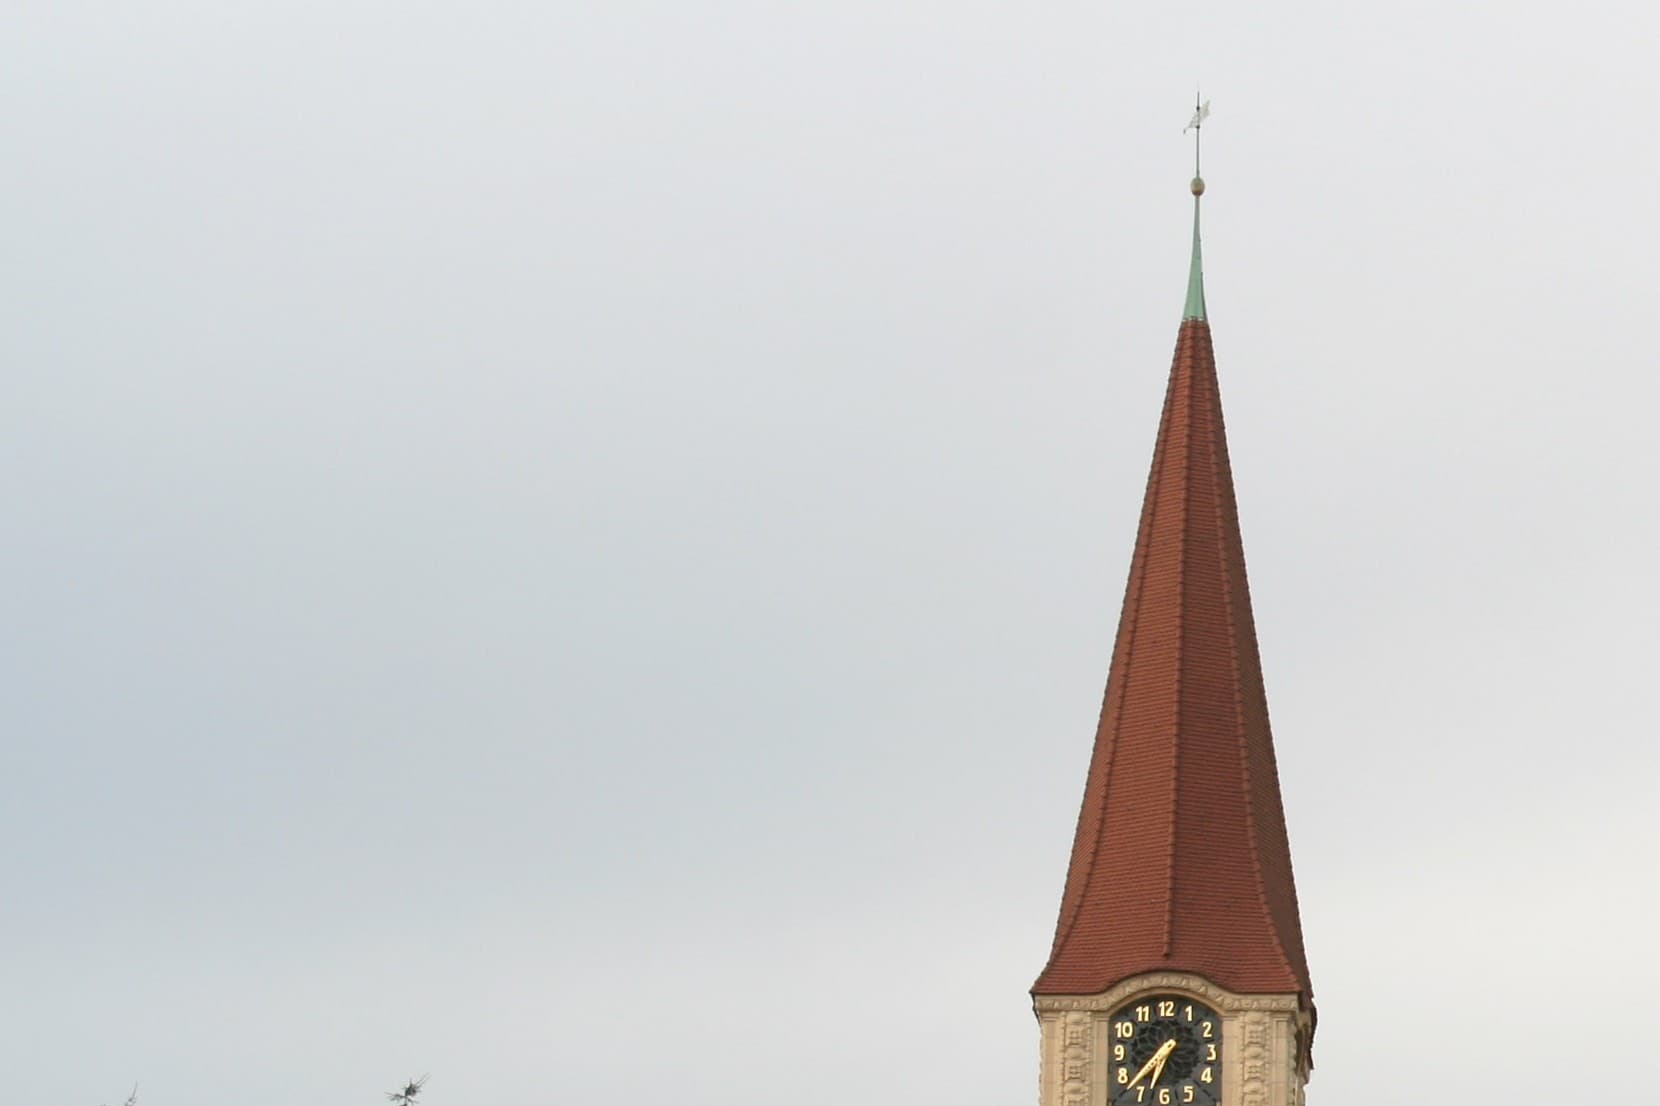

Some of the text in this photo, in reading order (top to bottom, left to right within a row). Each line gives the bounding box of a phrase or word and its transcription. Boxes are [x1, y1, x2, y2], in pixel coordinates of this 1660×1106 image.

[1135, 1006, 1150, 1022] 11
[1158, 1001, 1175, 1017] 12
[1185, 1005, 1193, 1022] 1
[1114, 1022, 1133, 1038] 10
[1202, 1021, 1213, 1038] 2
[1114, 1044, 1125, 1061] 9
[1206, 1044, 1217, 1061] 3
[1117, 1068, 1128, 1084] 8
[1201, 1067, 1212, 1083] 4
[1136, 1086, 1145, 1102] 7
[1159, 1088, 1170, 1105] 6
[1183, 1085, 1194, 1102] 5
